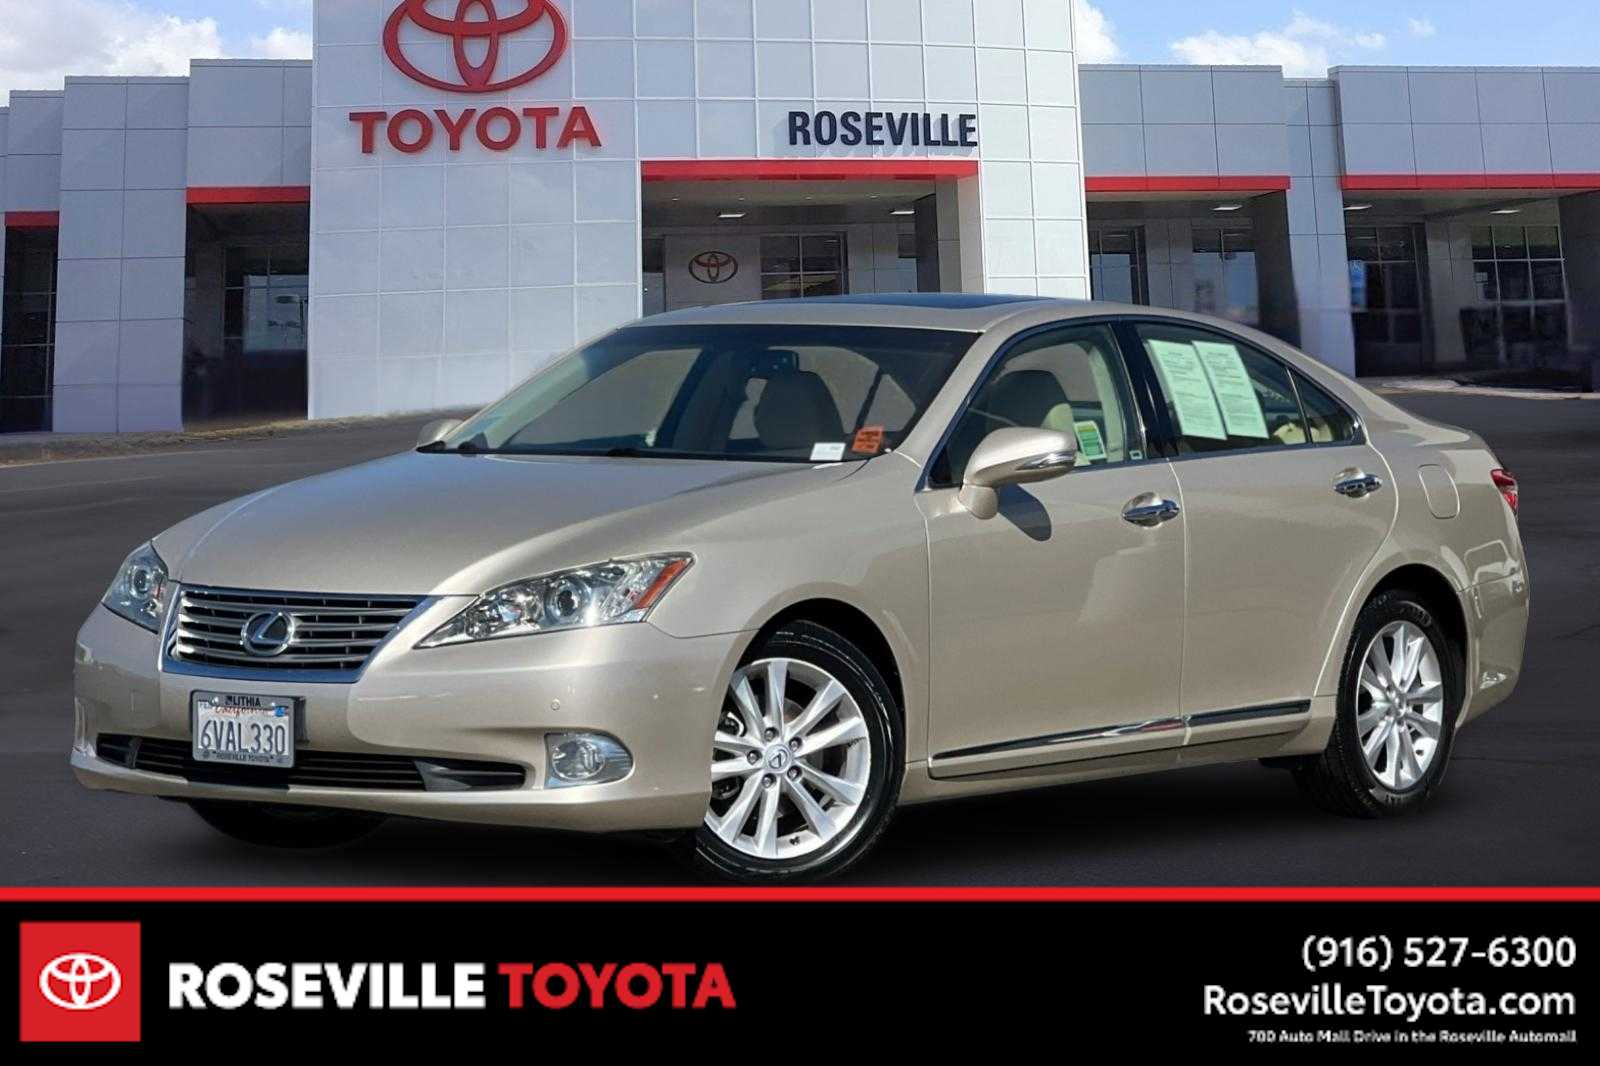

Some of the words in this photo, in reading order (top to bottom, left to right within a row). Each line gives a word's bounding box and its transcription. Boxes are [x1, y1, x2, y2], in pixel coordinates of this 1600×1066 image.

[349, 106, 602, 154] TOYOTA
[788, 110, 978, 147] ROSEVILLE
[233, 696, 261, 707] LITHIA
[200, 720, 286, 755] 6VAL330
